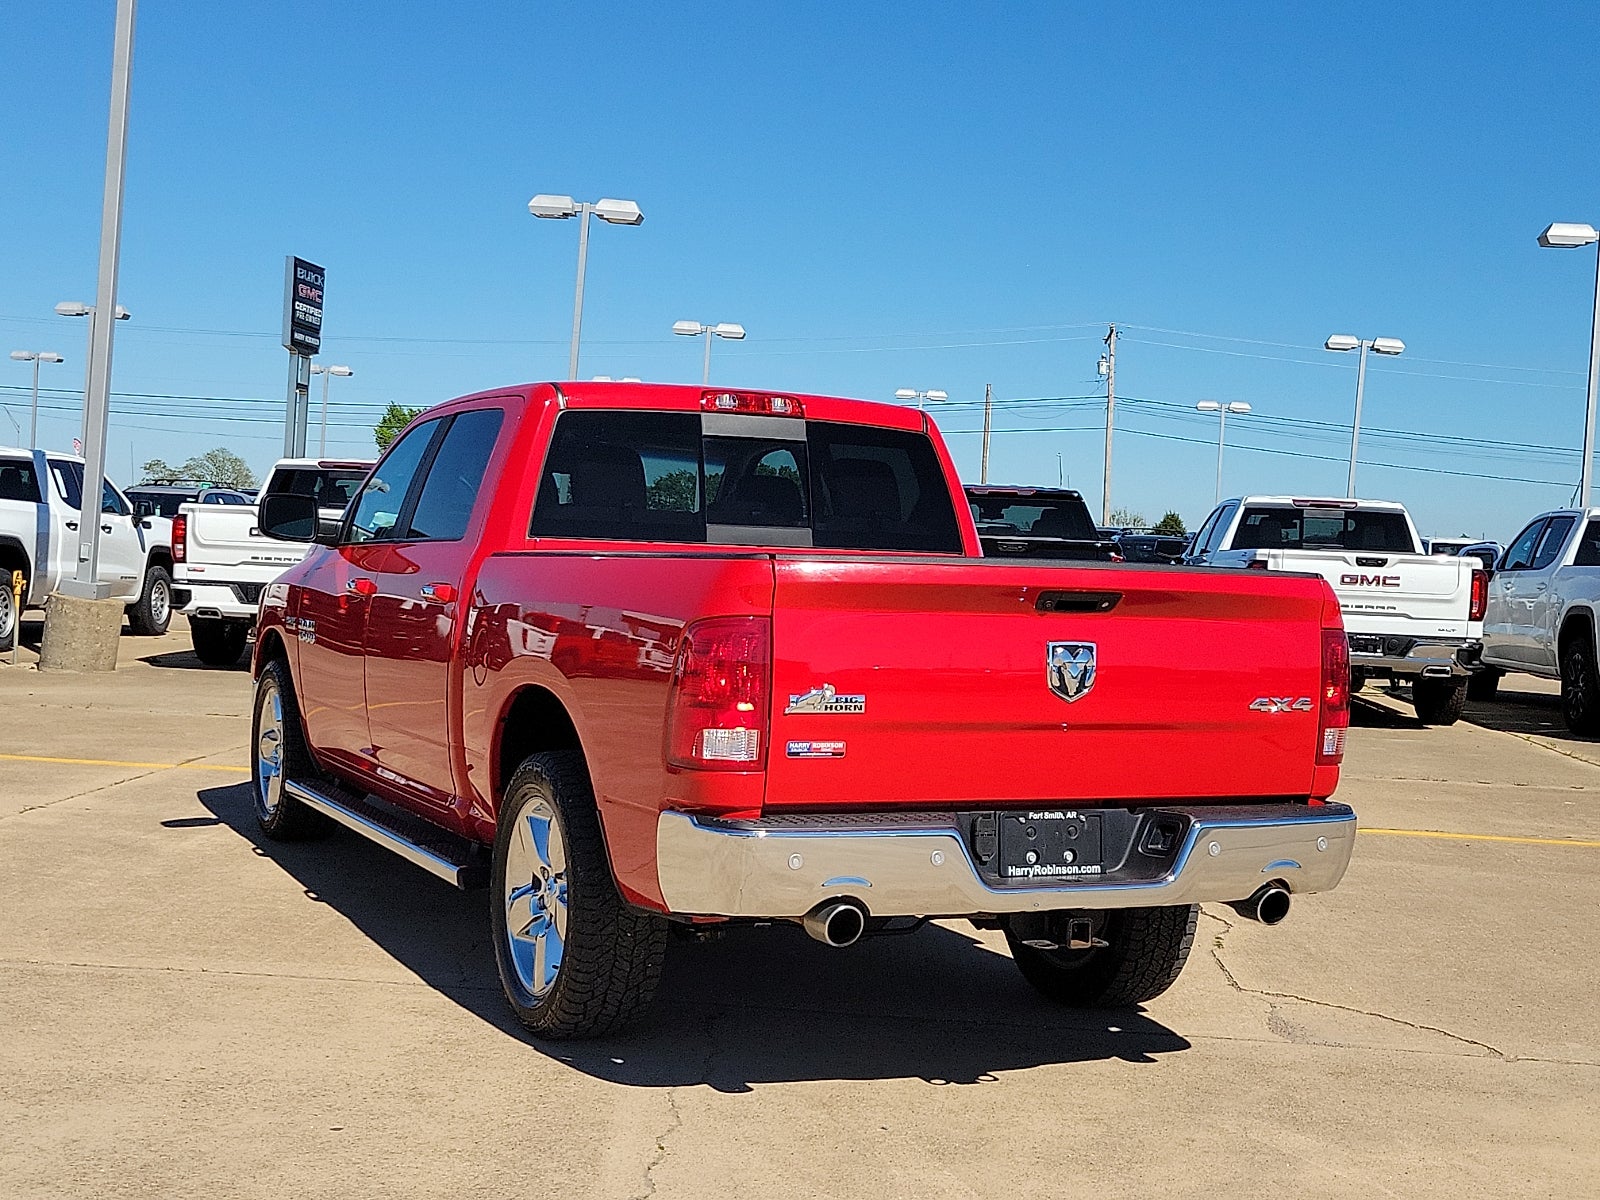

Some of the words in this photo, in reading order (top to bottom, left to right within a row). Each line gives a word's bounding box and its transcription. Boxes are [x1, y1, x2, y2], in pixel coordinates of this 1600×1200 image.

[297, 267, 324, 287] BUICK
[298, 284, 322, 303] GMC
[1340, 574, 1400, 587] GMC
[1044, 812, 1065, 820] Smith,
[1008, 865, 1101, 877] HarryRobinson.com
